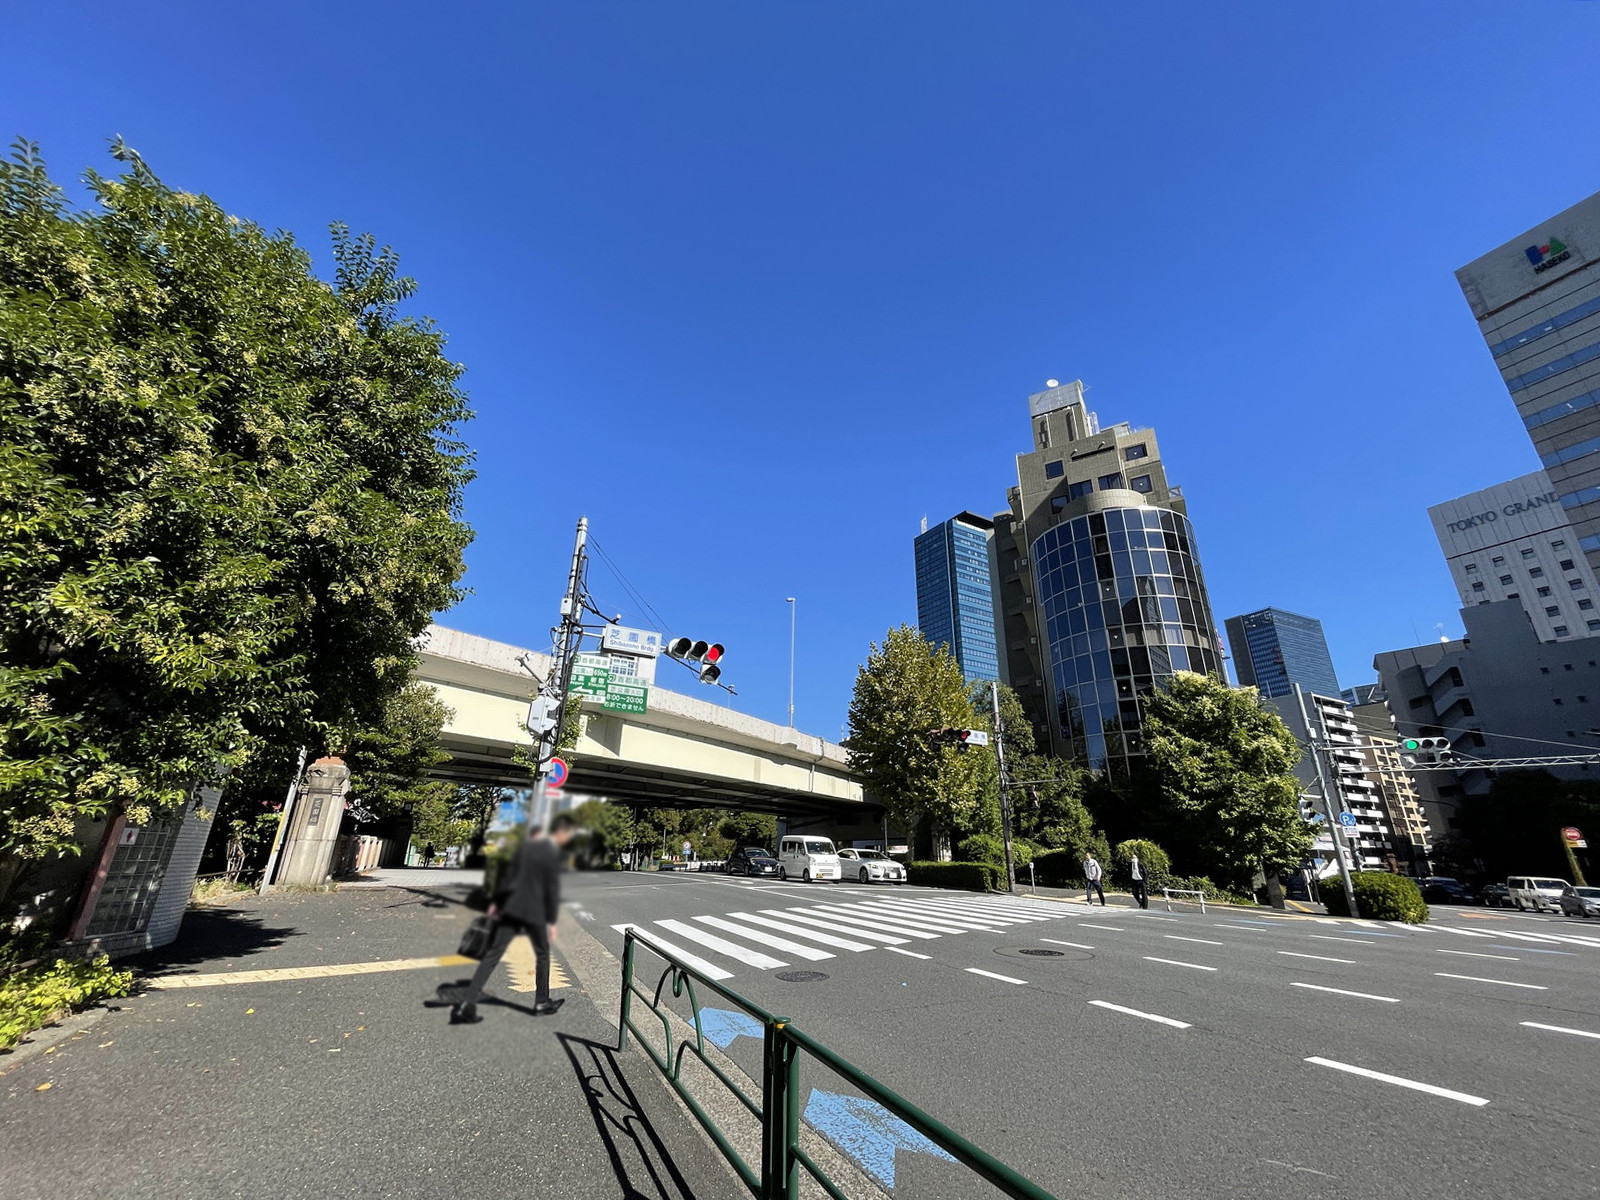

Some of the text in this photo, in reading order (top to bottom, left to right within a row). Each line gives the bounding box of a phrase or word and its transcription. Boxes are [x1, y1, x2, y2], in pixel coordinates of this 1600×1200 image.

[1447, 511, 1497, 533] TOKYO
[610, 628, 656, 646] 芝園橋
[610, 639, 639, 649] Shibazono
[582, 657, 608, 666] 首都高速
[618, 676, 648, 687] 首都高速
[610, 686, 642, 695] 芝公園入口
[604, 701, 644, 711] 右折できません
